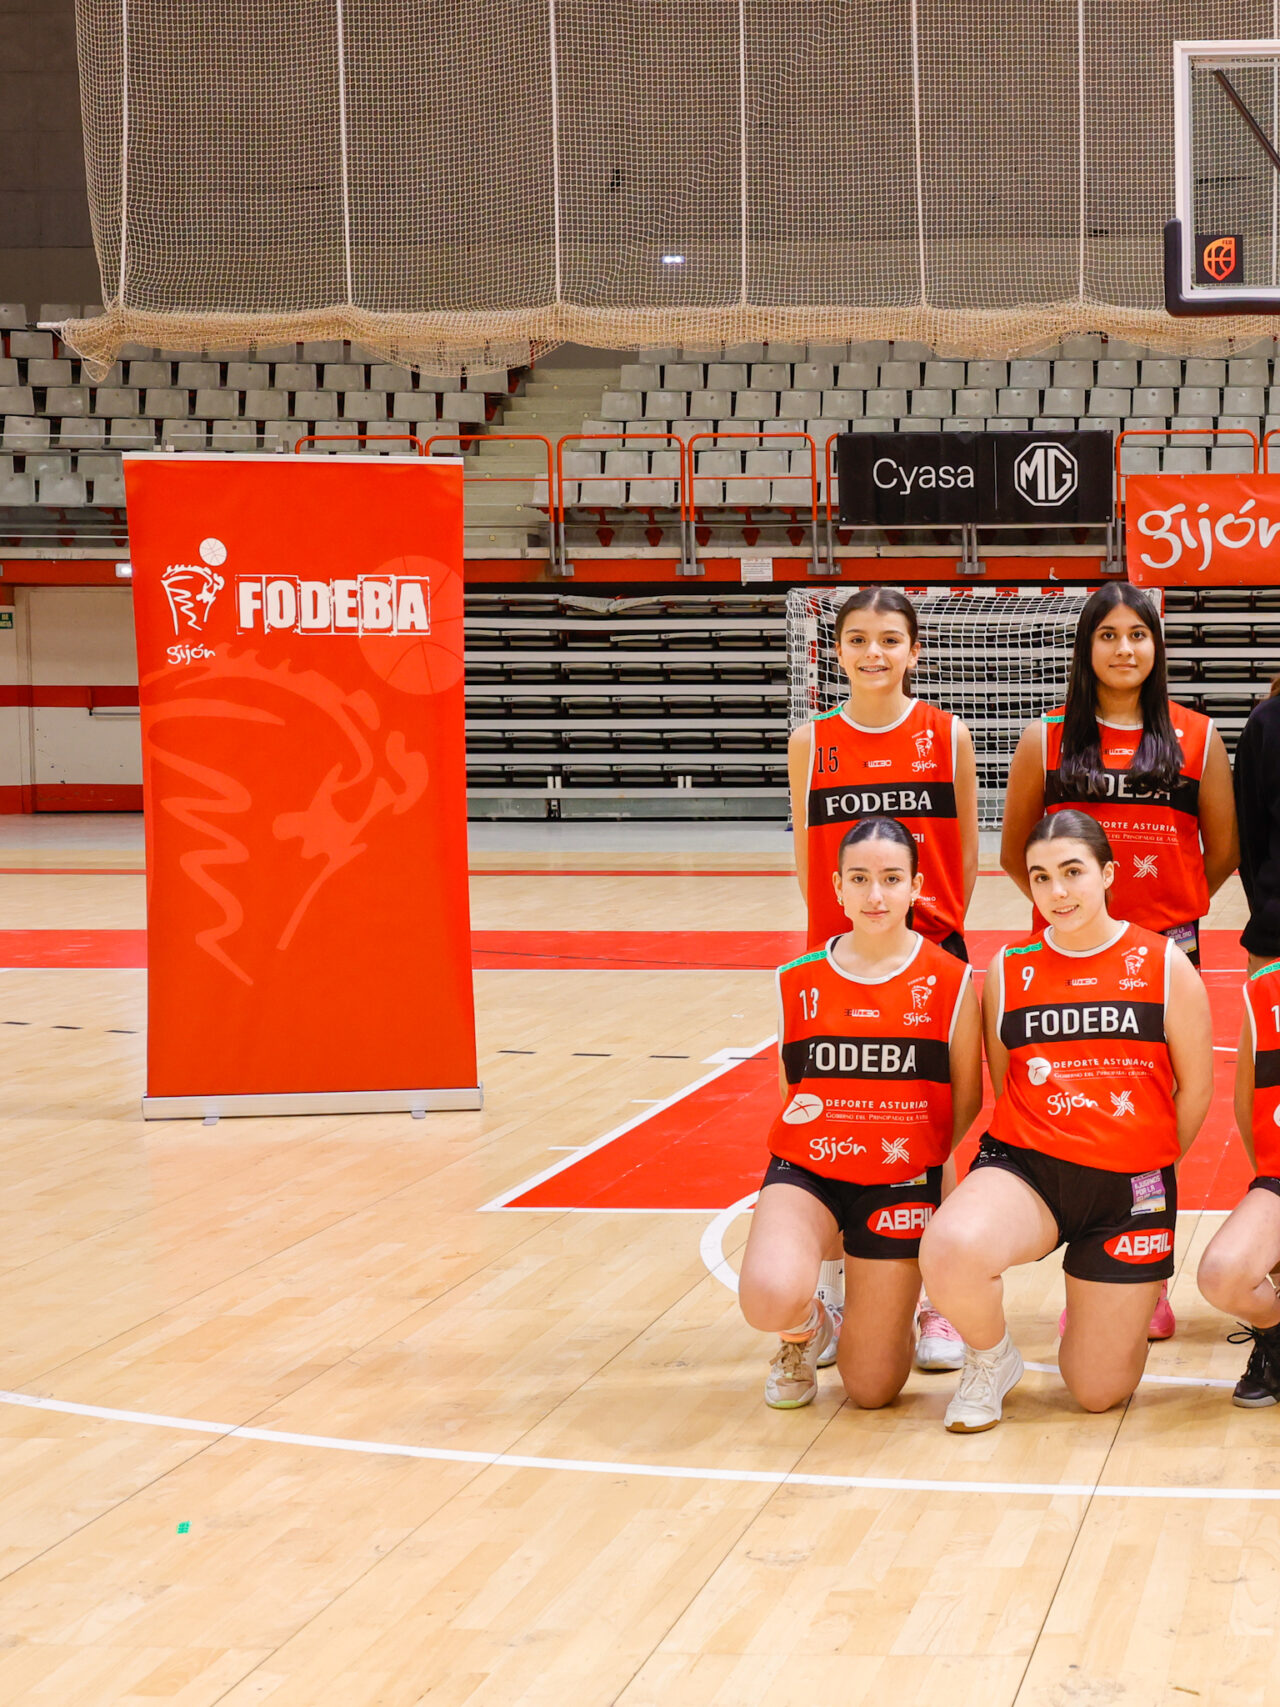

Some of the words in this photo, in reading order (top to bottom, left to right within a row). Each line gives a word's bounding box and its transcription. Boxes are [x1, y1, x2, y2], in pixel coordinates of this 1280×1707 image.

[873, 458, 974, 495] Cyasa
[1019, 447, 1073, 501] MG
[238, 578, 430, 631] FODEBA
[166, 643, 216, 665] gijón
[817, 746, 839, 774] 15
[825, 790, 933, 816] FODEBA
[1021, 965, 1034, 992] 9
[799, 987, 819, 1021] 13
[1025, 1006, 1140, 1038] FODEBA
[1053, 1057, 1100, 1069] DEPORTE
[825, 1099, 874, 1109] DEPORTE
[1046, 1091, 1099, 1116] gijón
[808, 1136, 868, 1163] gijón
[1113, 1232, 1171, 1257] ABRIL
